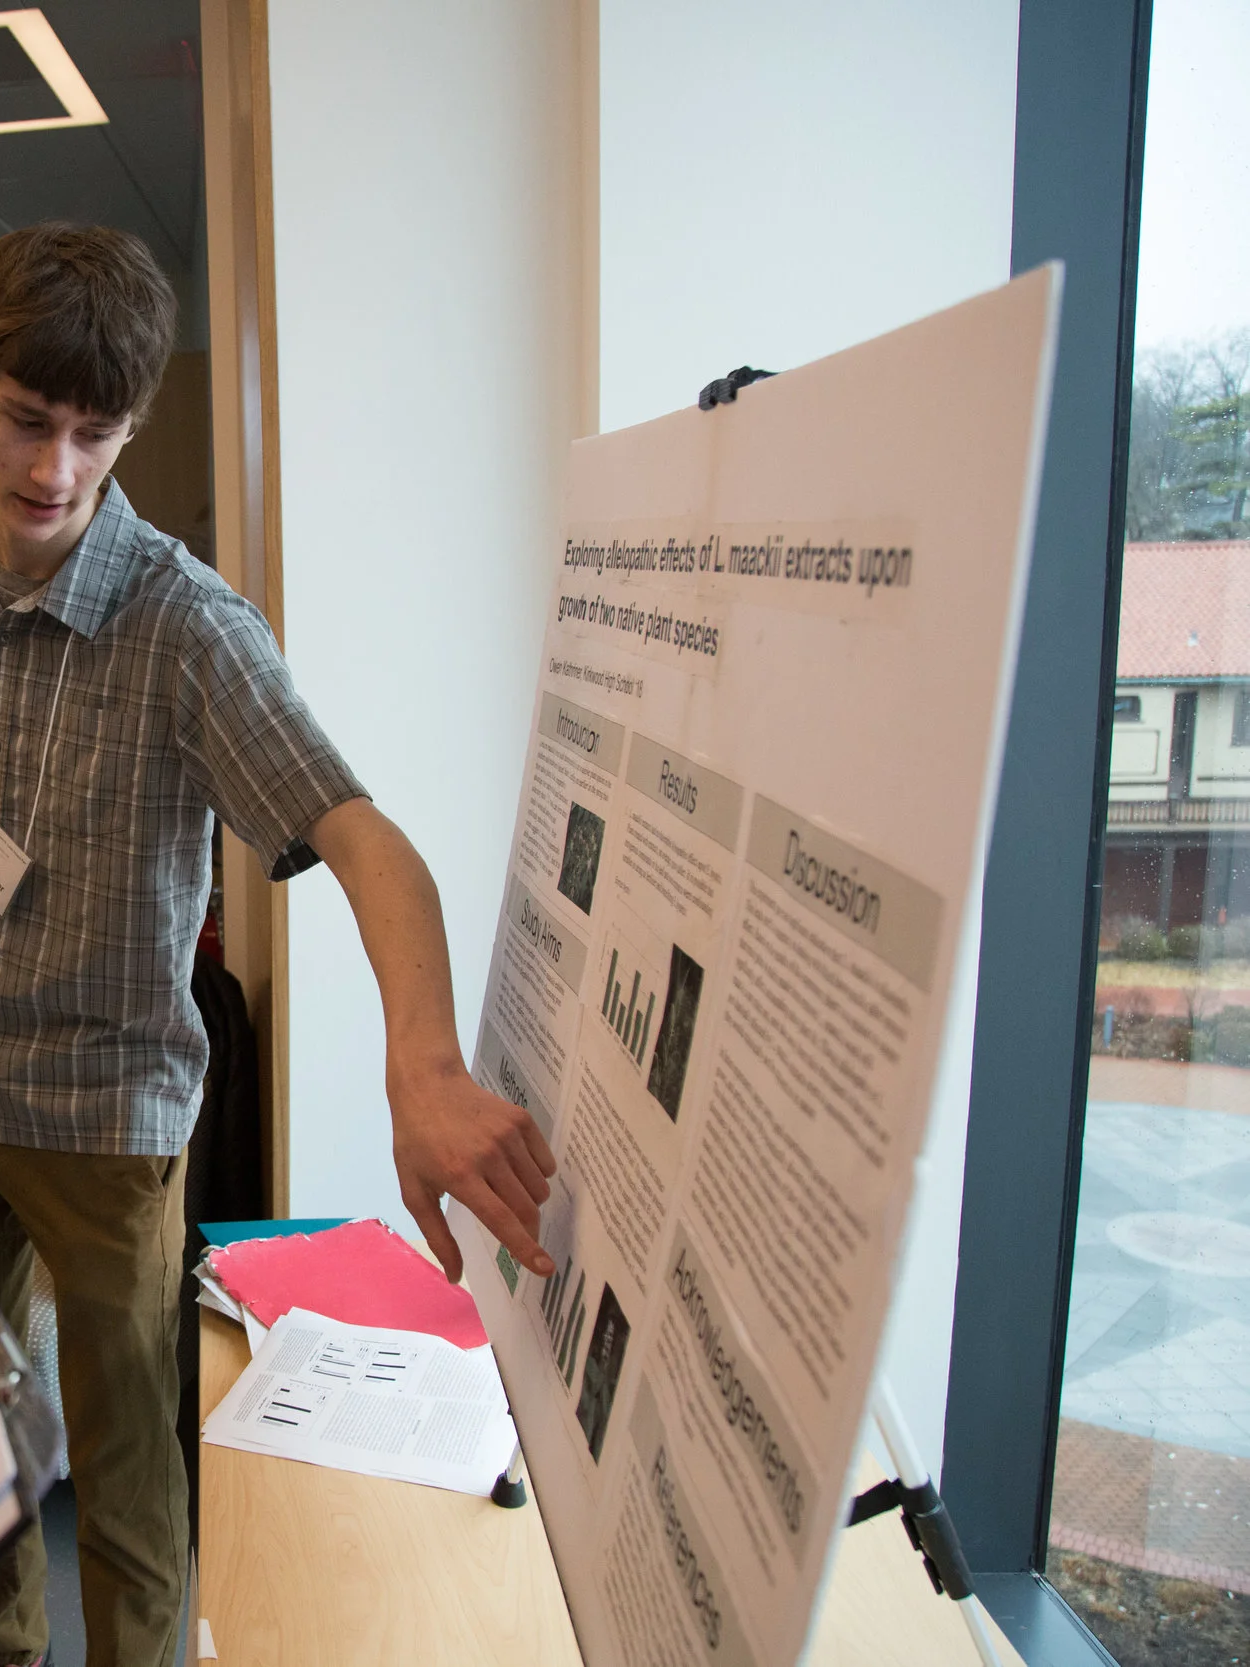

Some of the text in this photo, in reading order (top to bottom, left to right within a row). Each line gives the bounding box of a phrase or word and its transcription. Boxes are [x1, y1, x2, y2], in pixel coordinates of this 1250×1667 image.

[564, 539, 605, 576] Exploring
[605, 539, 658, 577] allelopathic
[659, 537, 696, 573] effects
[699, 534, 714, 572] of
[728, 535, 784, 577] maackii
[785, 537, 854, 584] extracts
[857, 545, 914, 599] upon
[558, 593, 719, 657] growth of two native plant species
[556, 707, 600, 756] Introduction
[658, 759, 698, 814] Results
[783, 828, 881, 935] Discussion
[521, 898, 562, 963] Study Aims
[672, 1248, 804, 1535] Acknowledgements
[651, 1444, 722, 1650] References
